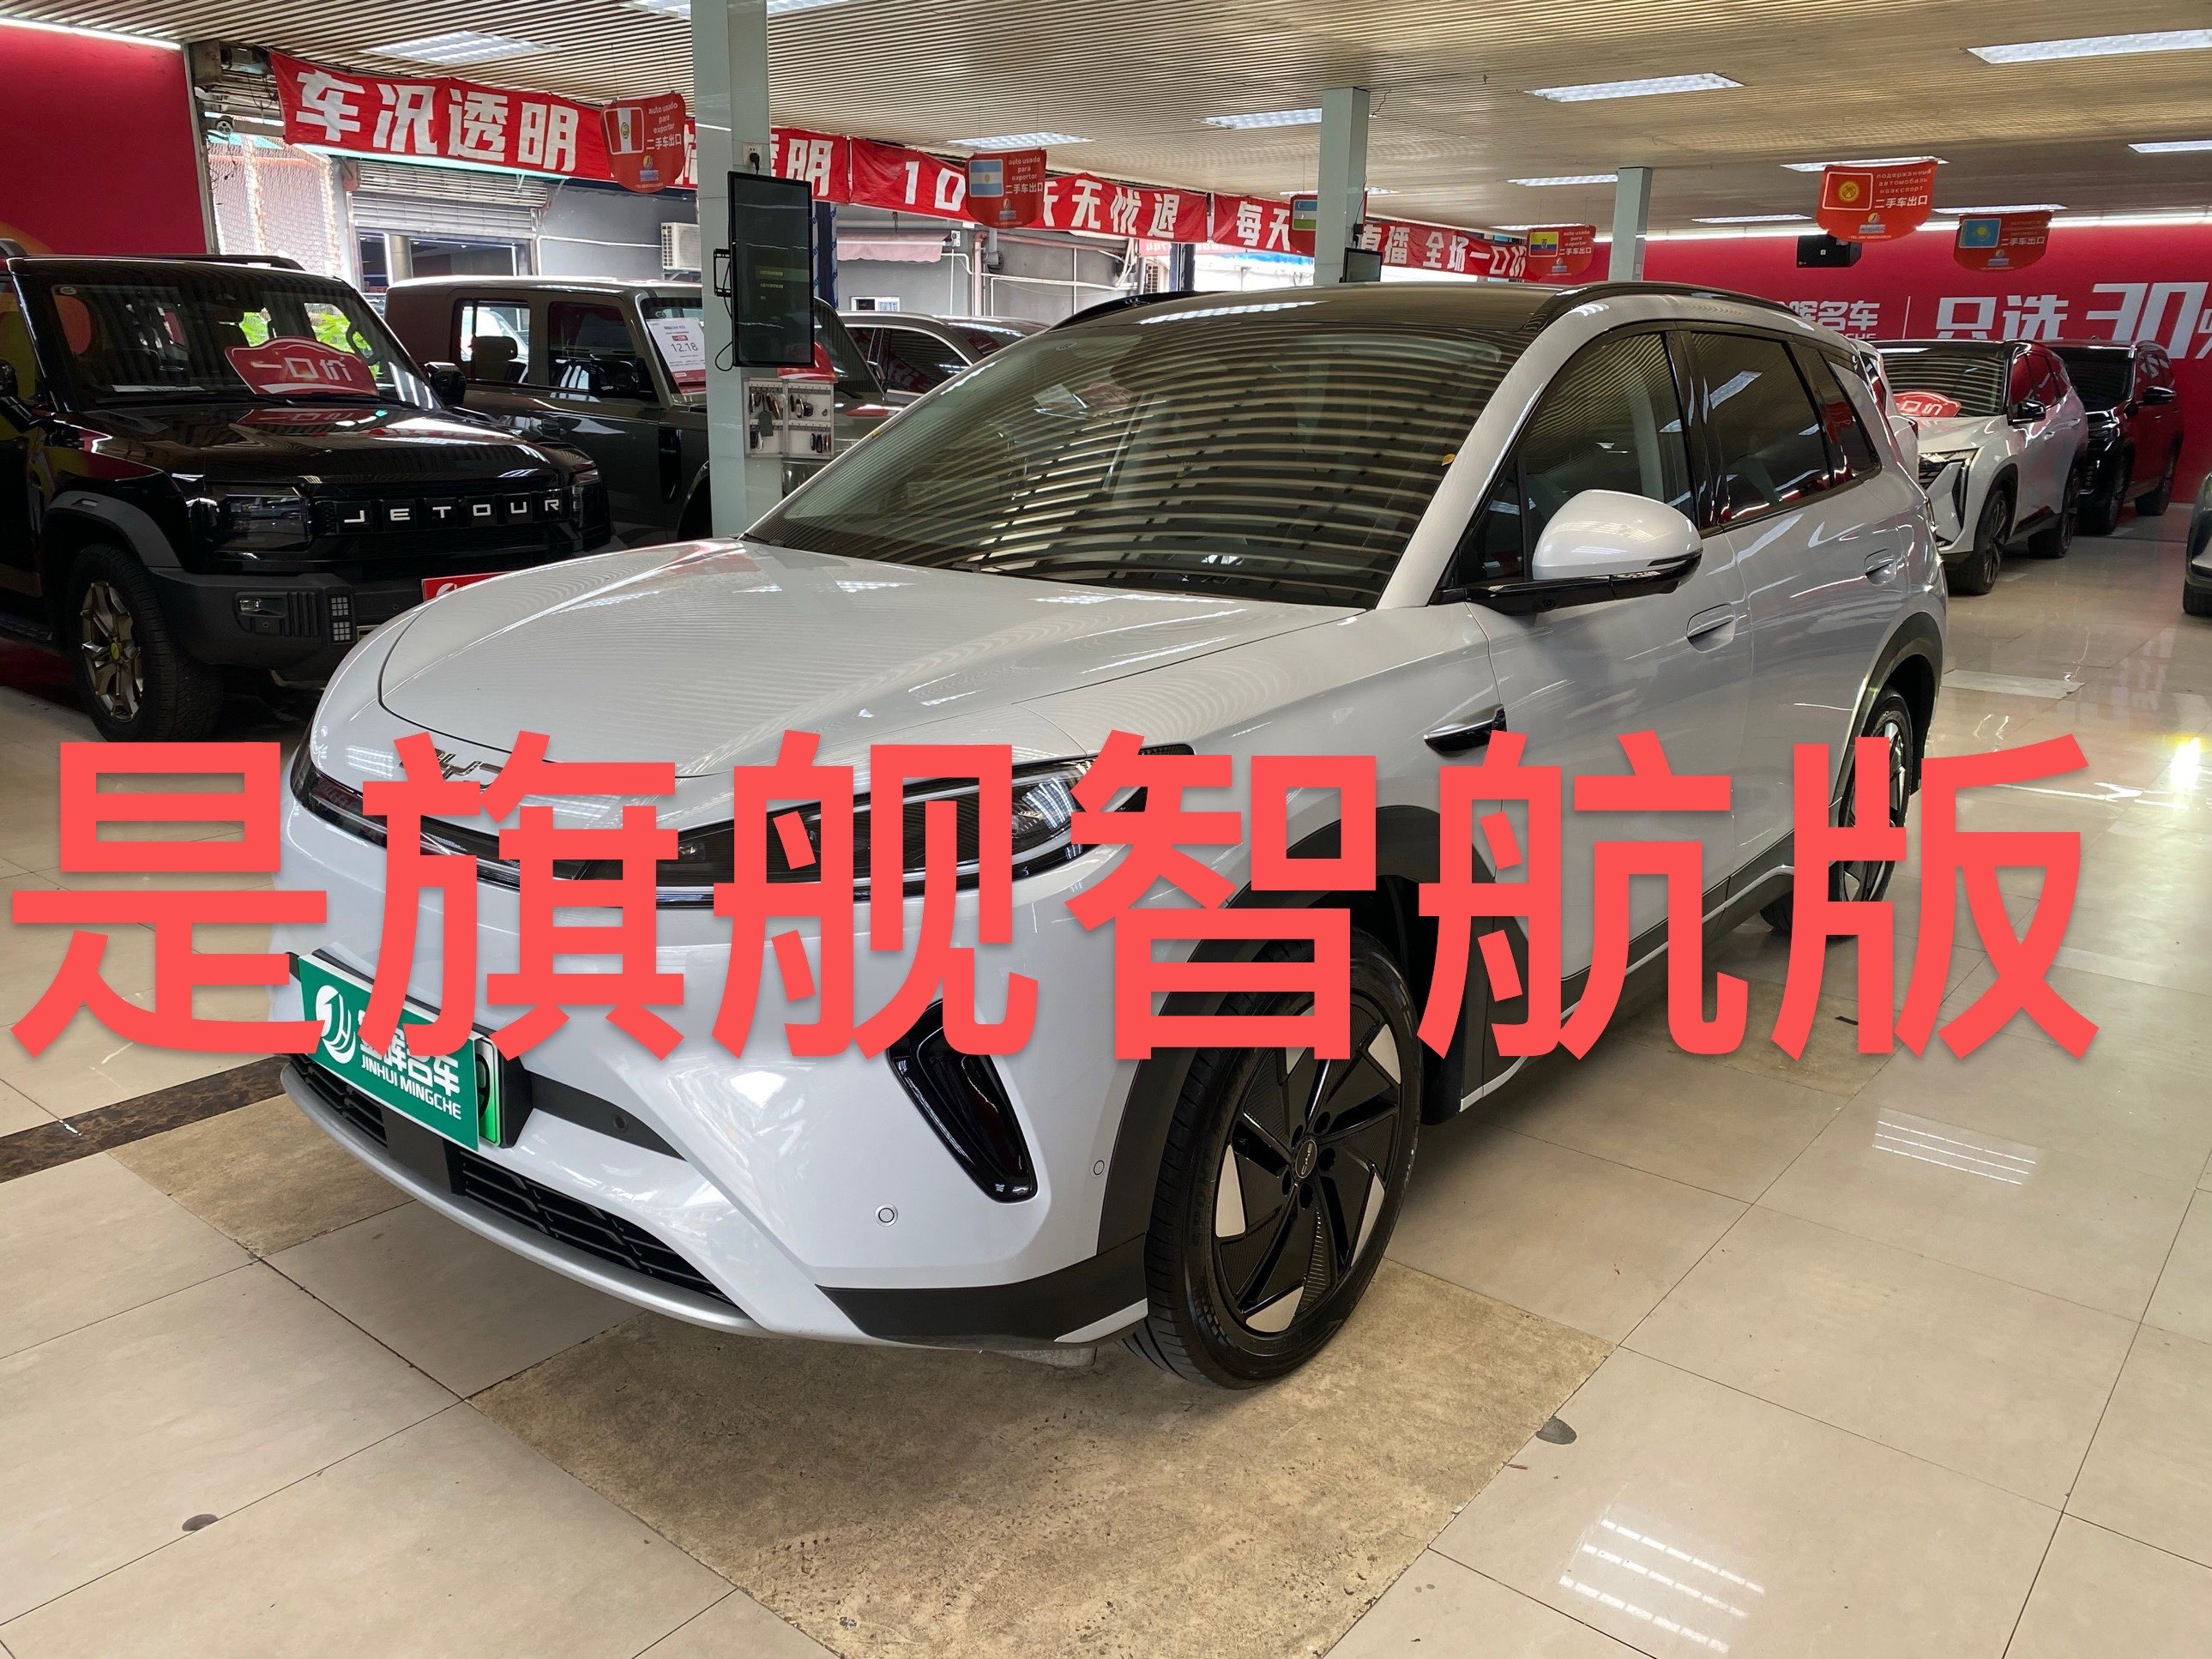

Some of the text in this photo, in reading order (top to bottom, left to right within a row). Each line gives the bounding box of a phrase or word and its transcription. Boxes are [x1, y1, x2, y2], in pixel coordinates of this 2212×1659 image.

[648, 106, 662, 115] auto
[658, 114, 670, 124] para
[646, 133, 682, 150] 二手车出口
[1022, 156, 1040, 165] usado
[1017, 166, 1031, 174] para
[1011, 173, 1038, 182] exportar
[1878, 178, 1928, 187] автомобиль
[1005, 182, 1044, 194] 二手车出口
[1874, 195, 1928, 208] 二手车出口
[2001, 236, 2046, 246] 二手车出口
[1559, 247, 1592, 256] 二手车出口
[1779, 300, 1880, 331] 辉名车
[250, 356, 353, 382] 一口价
[344, 499, 559, 523] JETOUR
[361, 1054, 398, 1087] JINHUI
[400, 1074, 462, 1120] MINGCHE
